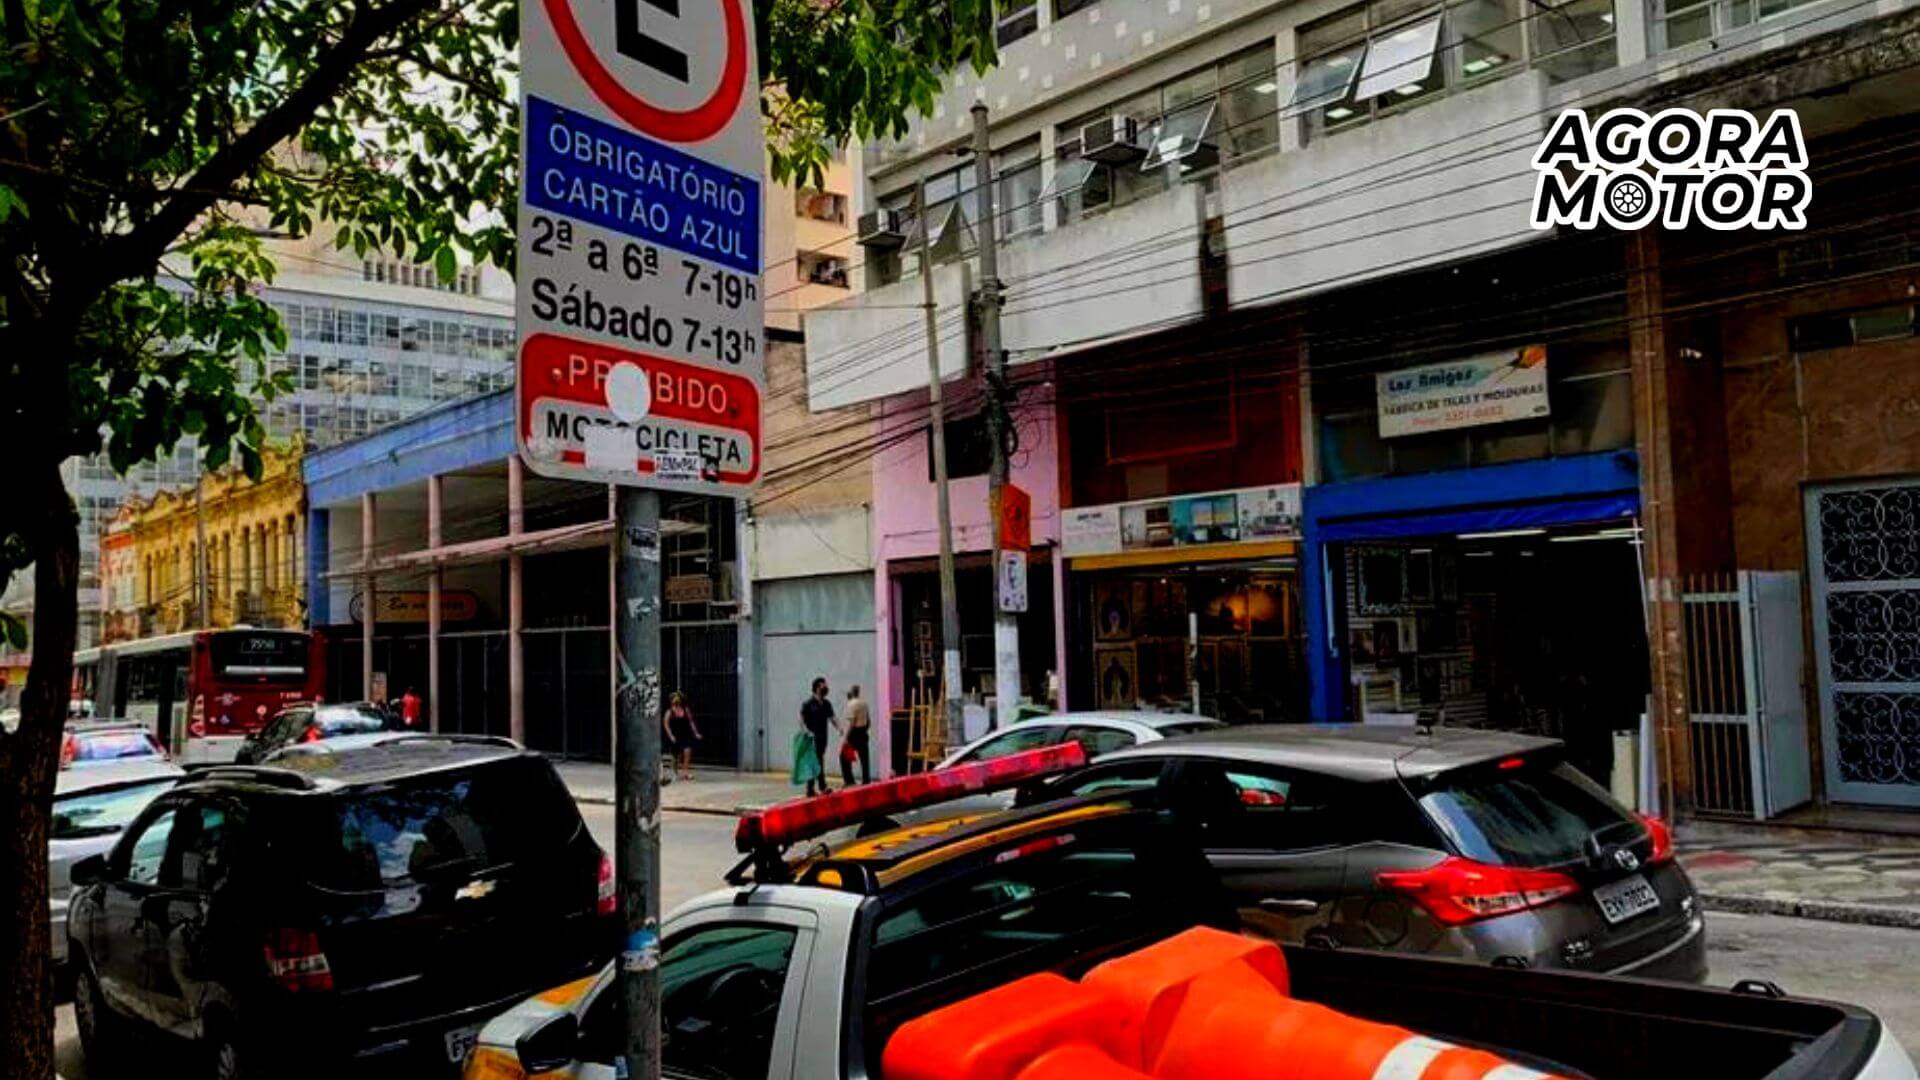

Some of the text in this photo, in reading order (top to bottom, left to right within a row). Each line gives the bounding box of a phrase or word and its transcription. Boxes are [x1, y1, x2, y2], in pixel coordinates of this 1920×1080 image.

[615, 0, 689, 83] E
[549, 121, 746, 217] OBRIGATÓRIO
[543, 167, 749, 260] CARTÃO AZUL
[587, 238, 609, 273] a
[531, 277, 673, 348] Sábado
[568, 353, 728, 414] PRBIDO
[1427, 399, 1439, 410] DE
